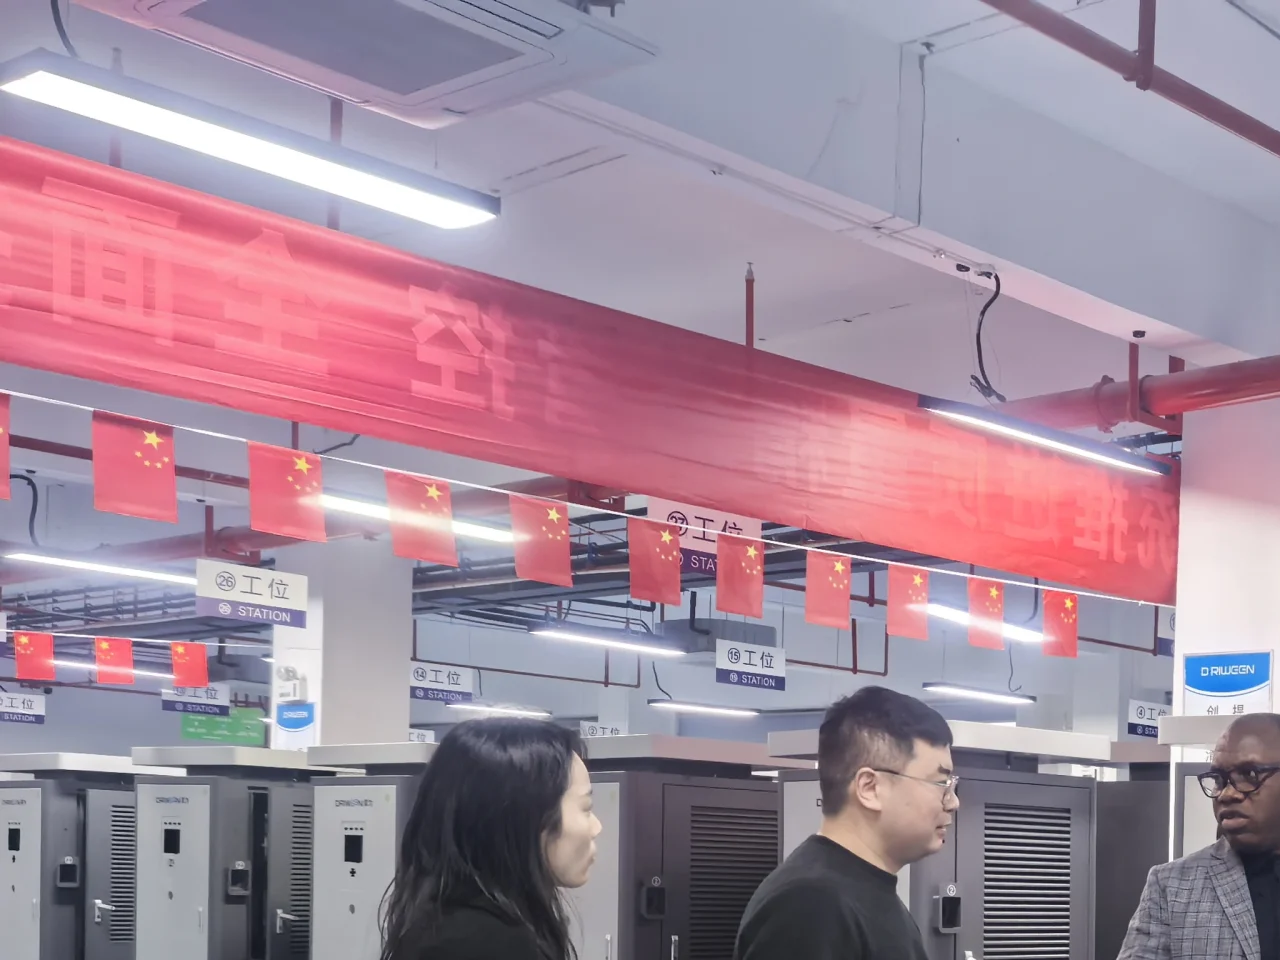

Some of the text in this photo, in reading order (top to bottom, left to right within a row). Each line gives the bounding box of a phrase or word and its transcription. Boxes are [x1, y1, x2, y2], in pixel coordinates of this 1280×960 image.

[238, 605, 291, 623] STATION
[741, 674, 776, 688] STATION
[427, 690, 462, 701] STATION
[187, 704, 220, 714] STATION
[4, 711, 35, 722] STATION
